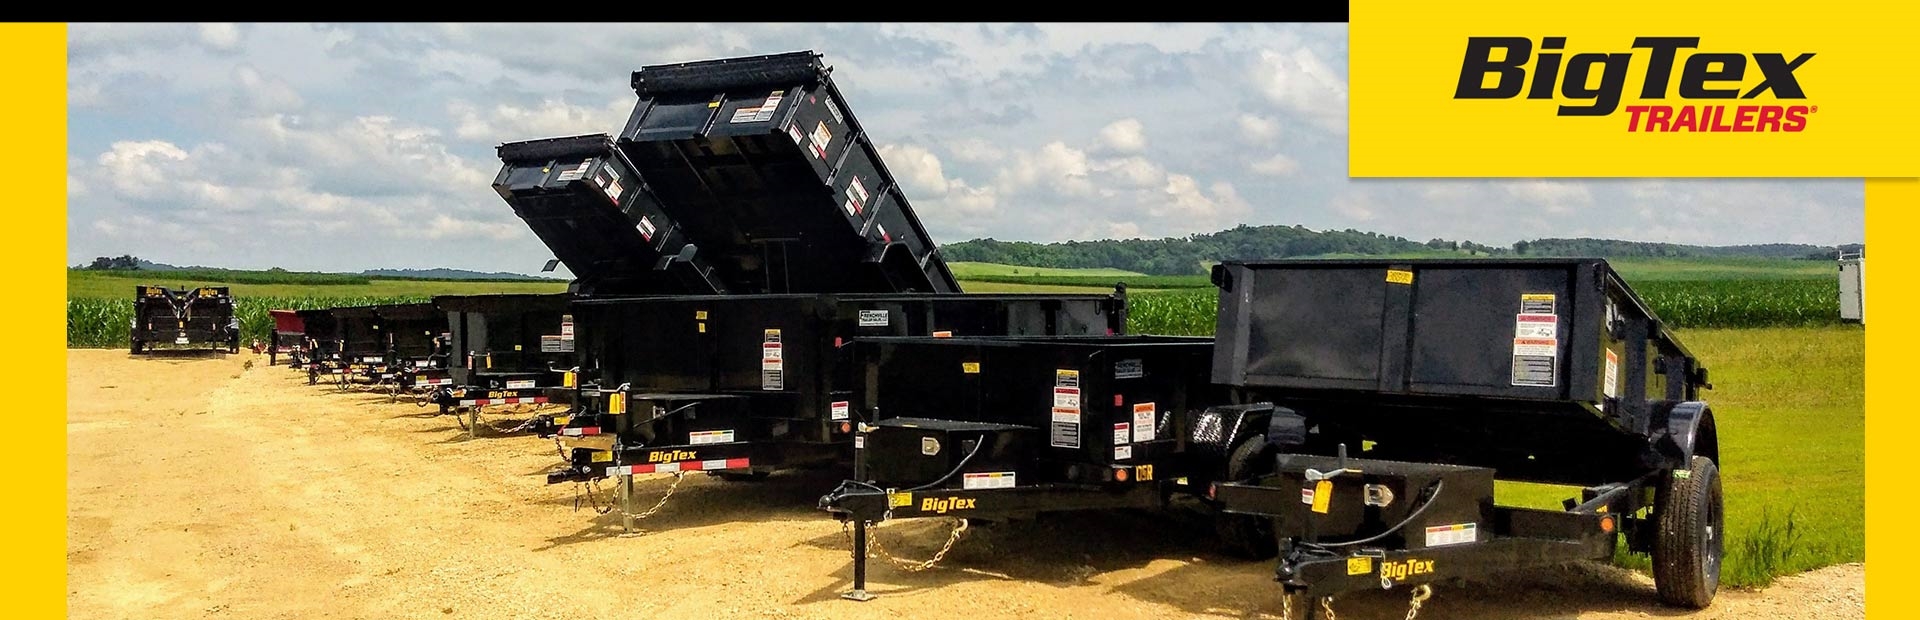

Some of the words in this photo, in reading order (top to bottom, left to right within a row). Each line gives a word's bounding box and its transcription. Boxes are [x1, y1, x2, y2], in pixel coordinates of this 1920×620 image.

[488, 390, 518, 399] BigTex
[648, 449, 697, 464] BigTex
[920, 496, 977, 514] BigTex
[1380, 558, 1435, 582] BigTex
